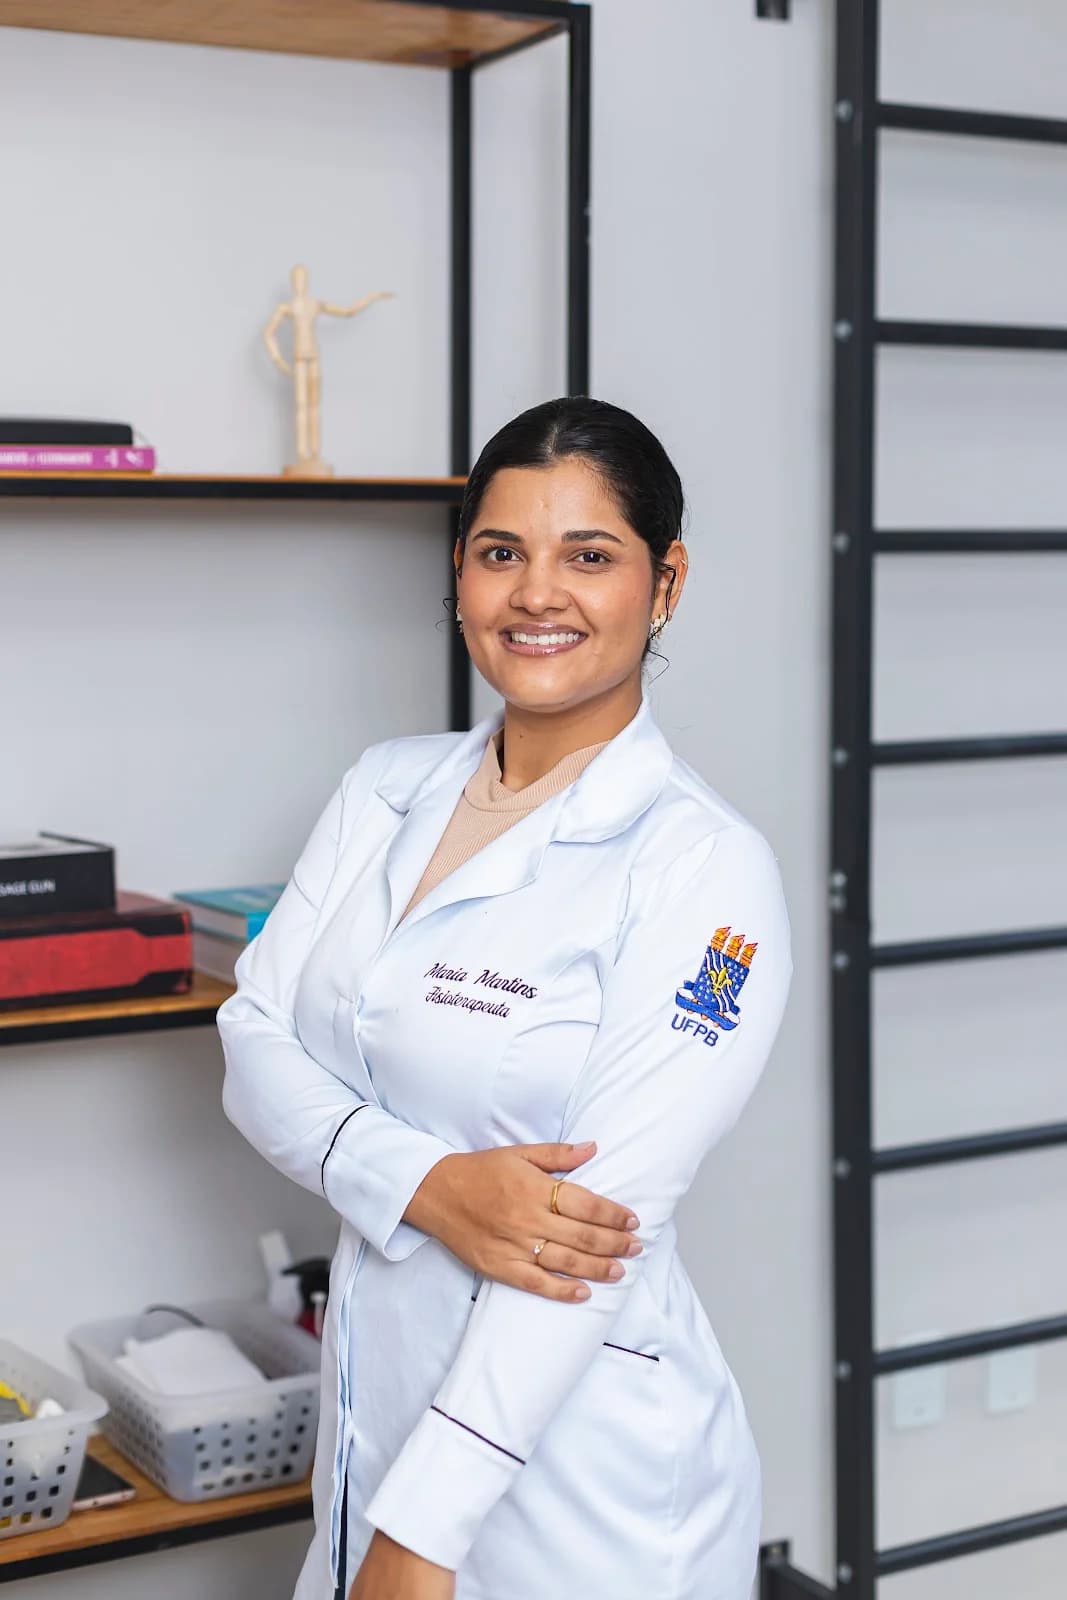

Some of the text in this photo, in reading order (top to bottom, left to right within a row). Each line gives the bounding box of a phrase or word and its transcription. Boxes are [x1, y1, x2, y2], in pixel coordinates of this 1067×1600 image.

[424, 963, 537, 998] Maria Martins
[425, 986, 510, 1018] Fisioterapeuta
[671, 1014, 719, 1047] UFPB
